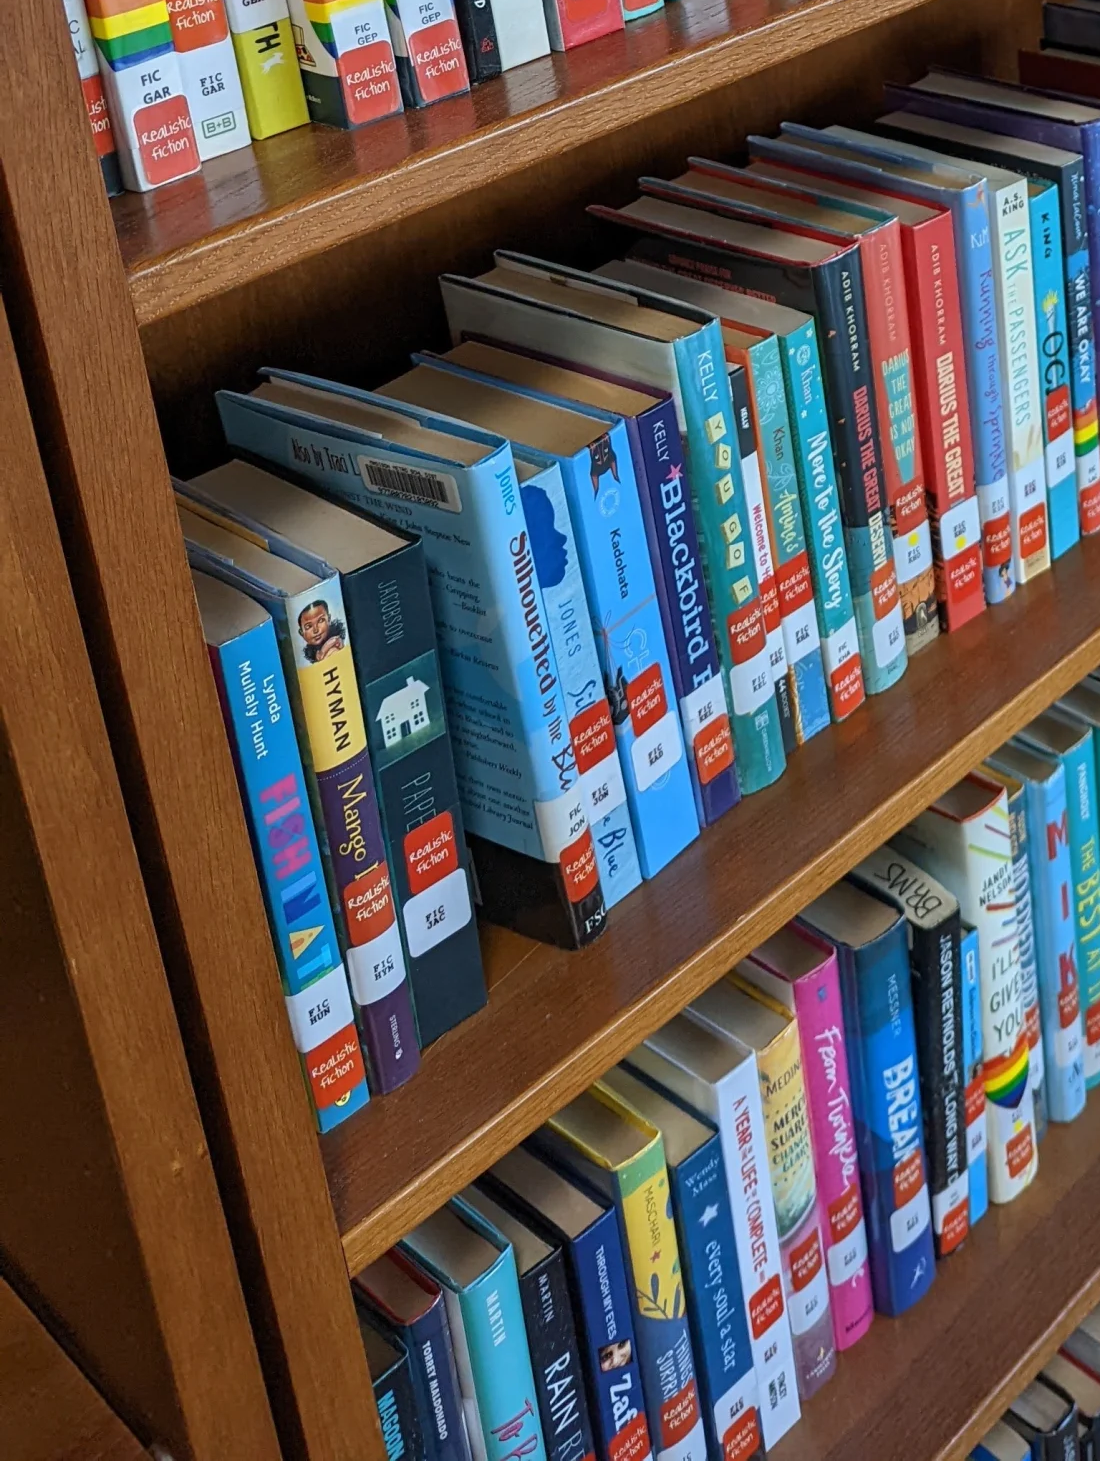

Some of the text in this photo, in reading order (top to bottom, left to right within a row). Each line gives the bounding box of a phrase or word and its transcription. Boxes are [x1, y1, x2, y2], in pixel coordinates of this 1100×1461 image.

[141, 70, 162, 87] FIC
[143, 86, 171, 105] GAR
[142, 115, 192, 145] Realistic
[1002, 200, 1025, 217] KING
[841, 271, 861, 372] ADIB KHORRAM
[934, 281, 947, 346] KHORRAM
[1004, 228, 1032, 428] ASK PASSENGERS
[697, 350, 719, 403] KELLY
[1078, 340, 1091, 383] OKAY
[652, 419, 670, 462] KELLY
[740, 406, 750, 429] KELLY
[772, 426, 784, 461] Khan
[936, 351, 965, 498] DARIUS GREAT
[853, 386, 882, 513] DARIUS GREAT
[494, 465, 516, 516] Jones
[807, 430, 843, 610] More Story
[609, 527, 630, 600] Kadohata
[660, 477, 711, 664] Blackbird
[377, 579, 405, 645] JACOBSON
[508, 530, 557, 696] Silhouetted
[558, 599, 582, 658] JONES
[238, 660, 268, 760] Mullaly Hunt
[263, 674, 282, 725] Lynda
[323, 667, 351, 753] HYMAN
[337, 773, 367, 862] Mango
[410, 829, 453, 862] Realistic
[416, 848, 450, 874] fiction
[598, 827, 628, 878] Blue
[425, 905, 446, 923] FIC
[427, 913, 446, 930] JAC
[308, 998, 329, 1018] FIC
[309, 1006, 331, 1026] HUN
[940, 934, 957, 1075] JASON REYNOLDS
[990, 975, 1021, 1013] GIVE
[594, 1244, 612, 1299] THROUGH
[704, 1240, 723, 1290] every
[486, 1290, 507, 1347] MARTIN
[538, 1273, 555, 1324] MARTIN
[422, 1341, 448, 1440] TORREY MALDONADO
[545, 1351, 581, 1436] RAIN
